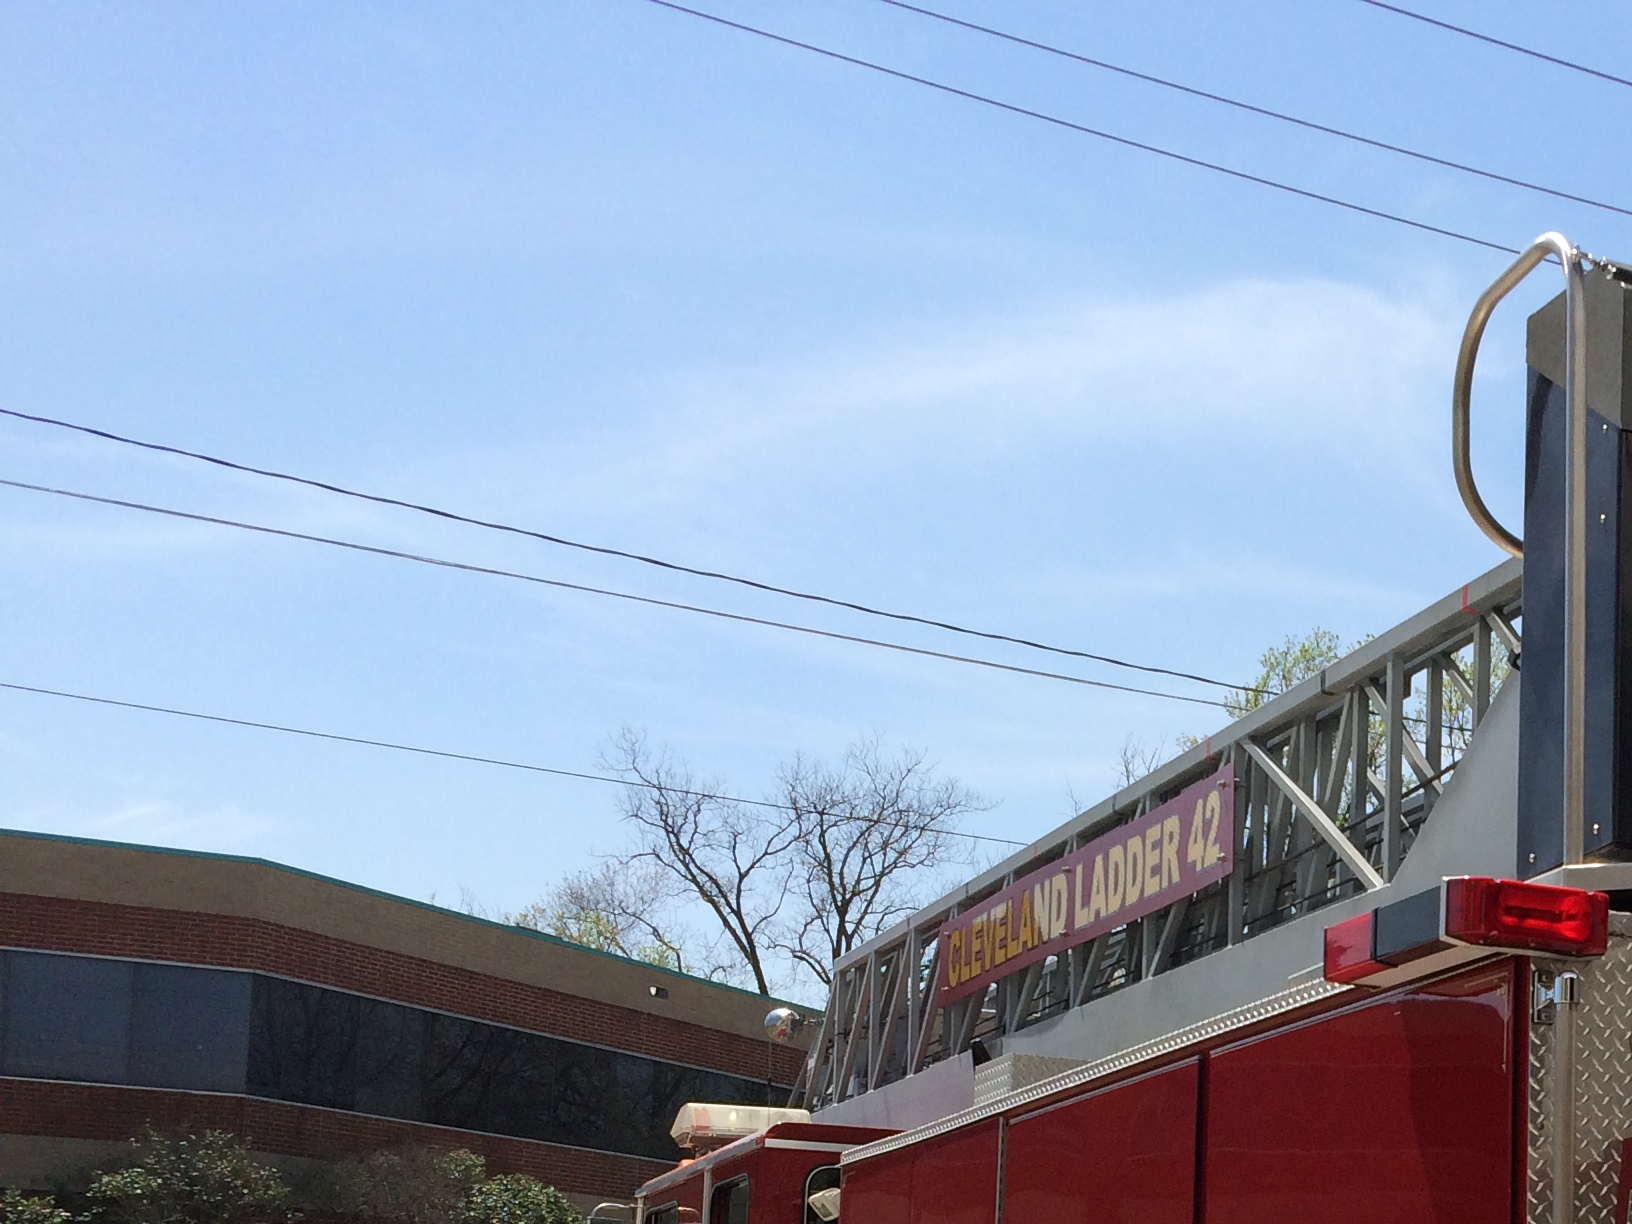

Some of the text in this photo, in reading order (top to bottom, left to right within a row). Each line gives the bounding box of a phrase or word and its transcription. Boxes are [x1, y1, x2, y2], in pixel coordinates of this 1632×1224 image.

[949, 790, 1222, 988] CLEVELAND LADDER 42
